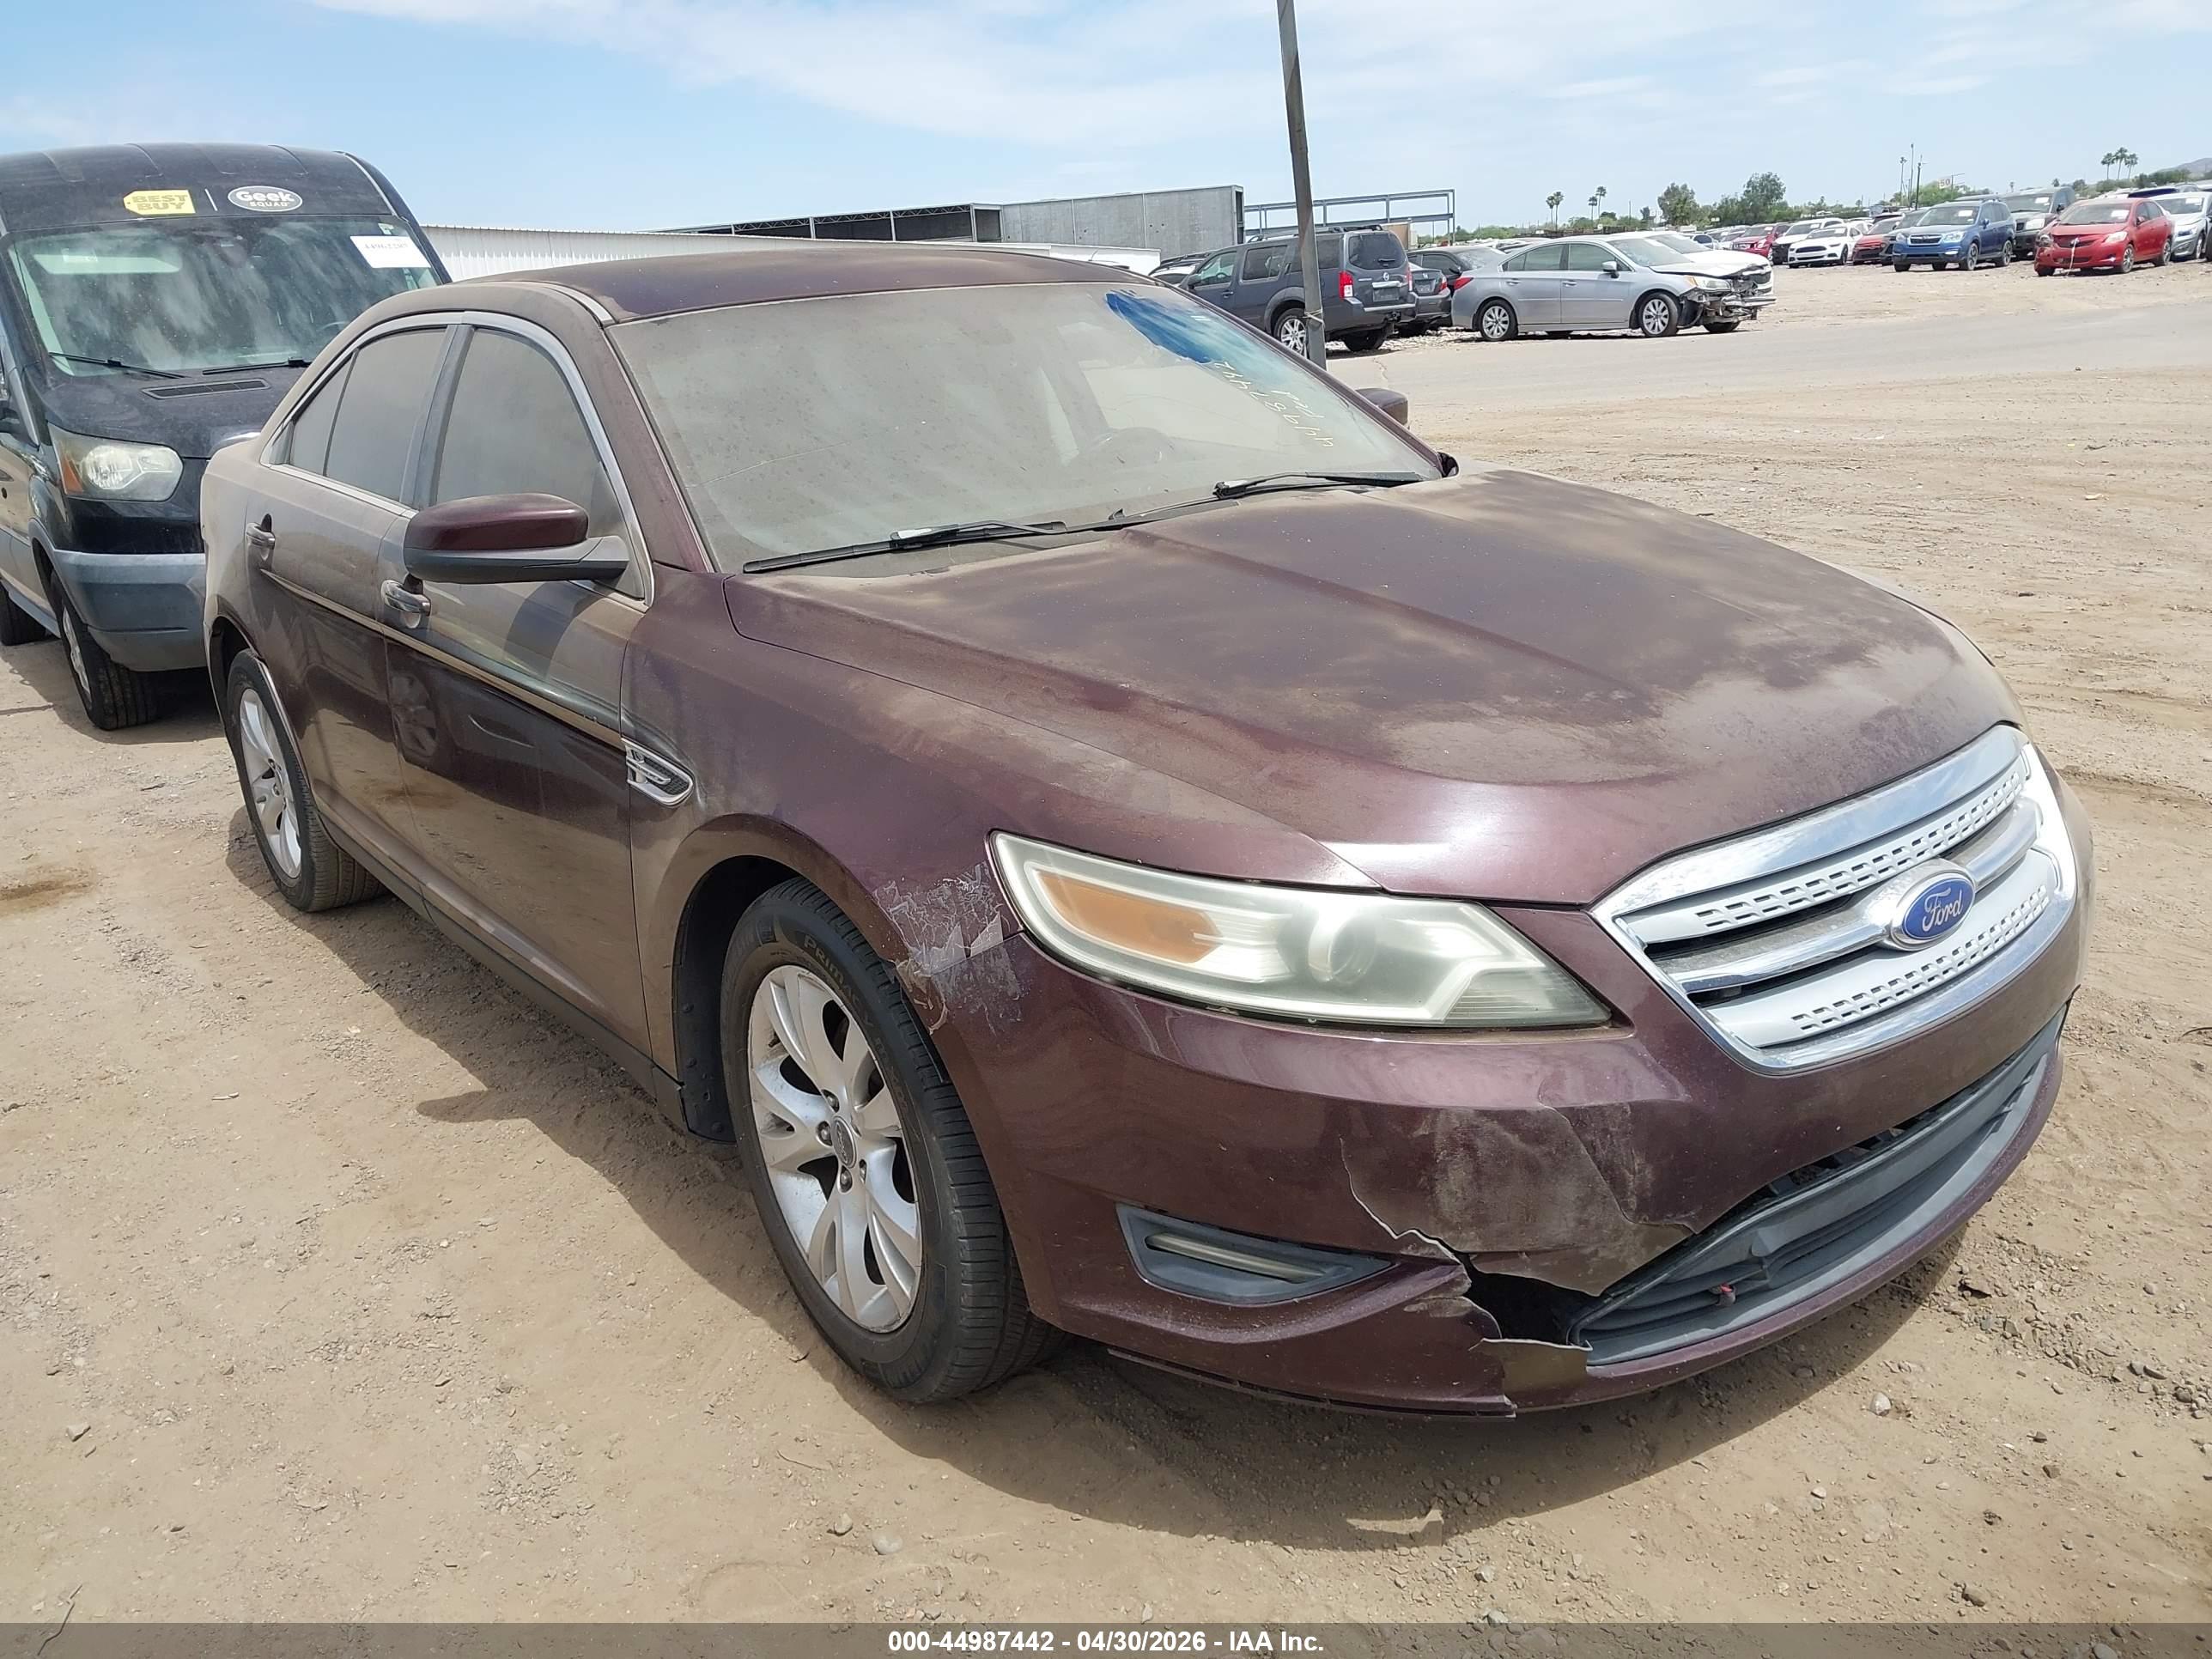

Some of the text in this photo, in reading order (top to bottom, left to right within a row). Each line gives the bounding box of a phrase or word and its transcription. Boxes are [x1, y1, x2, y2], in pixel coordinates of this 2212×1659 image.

[236, 191, 295, 202] Geek
[137, 202, 185, 210] BUY
[1923, 887, 1963, 932] Ford
